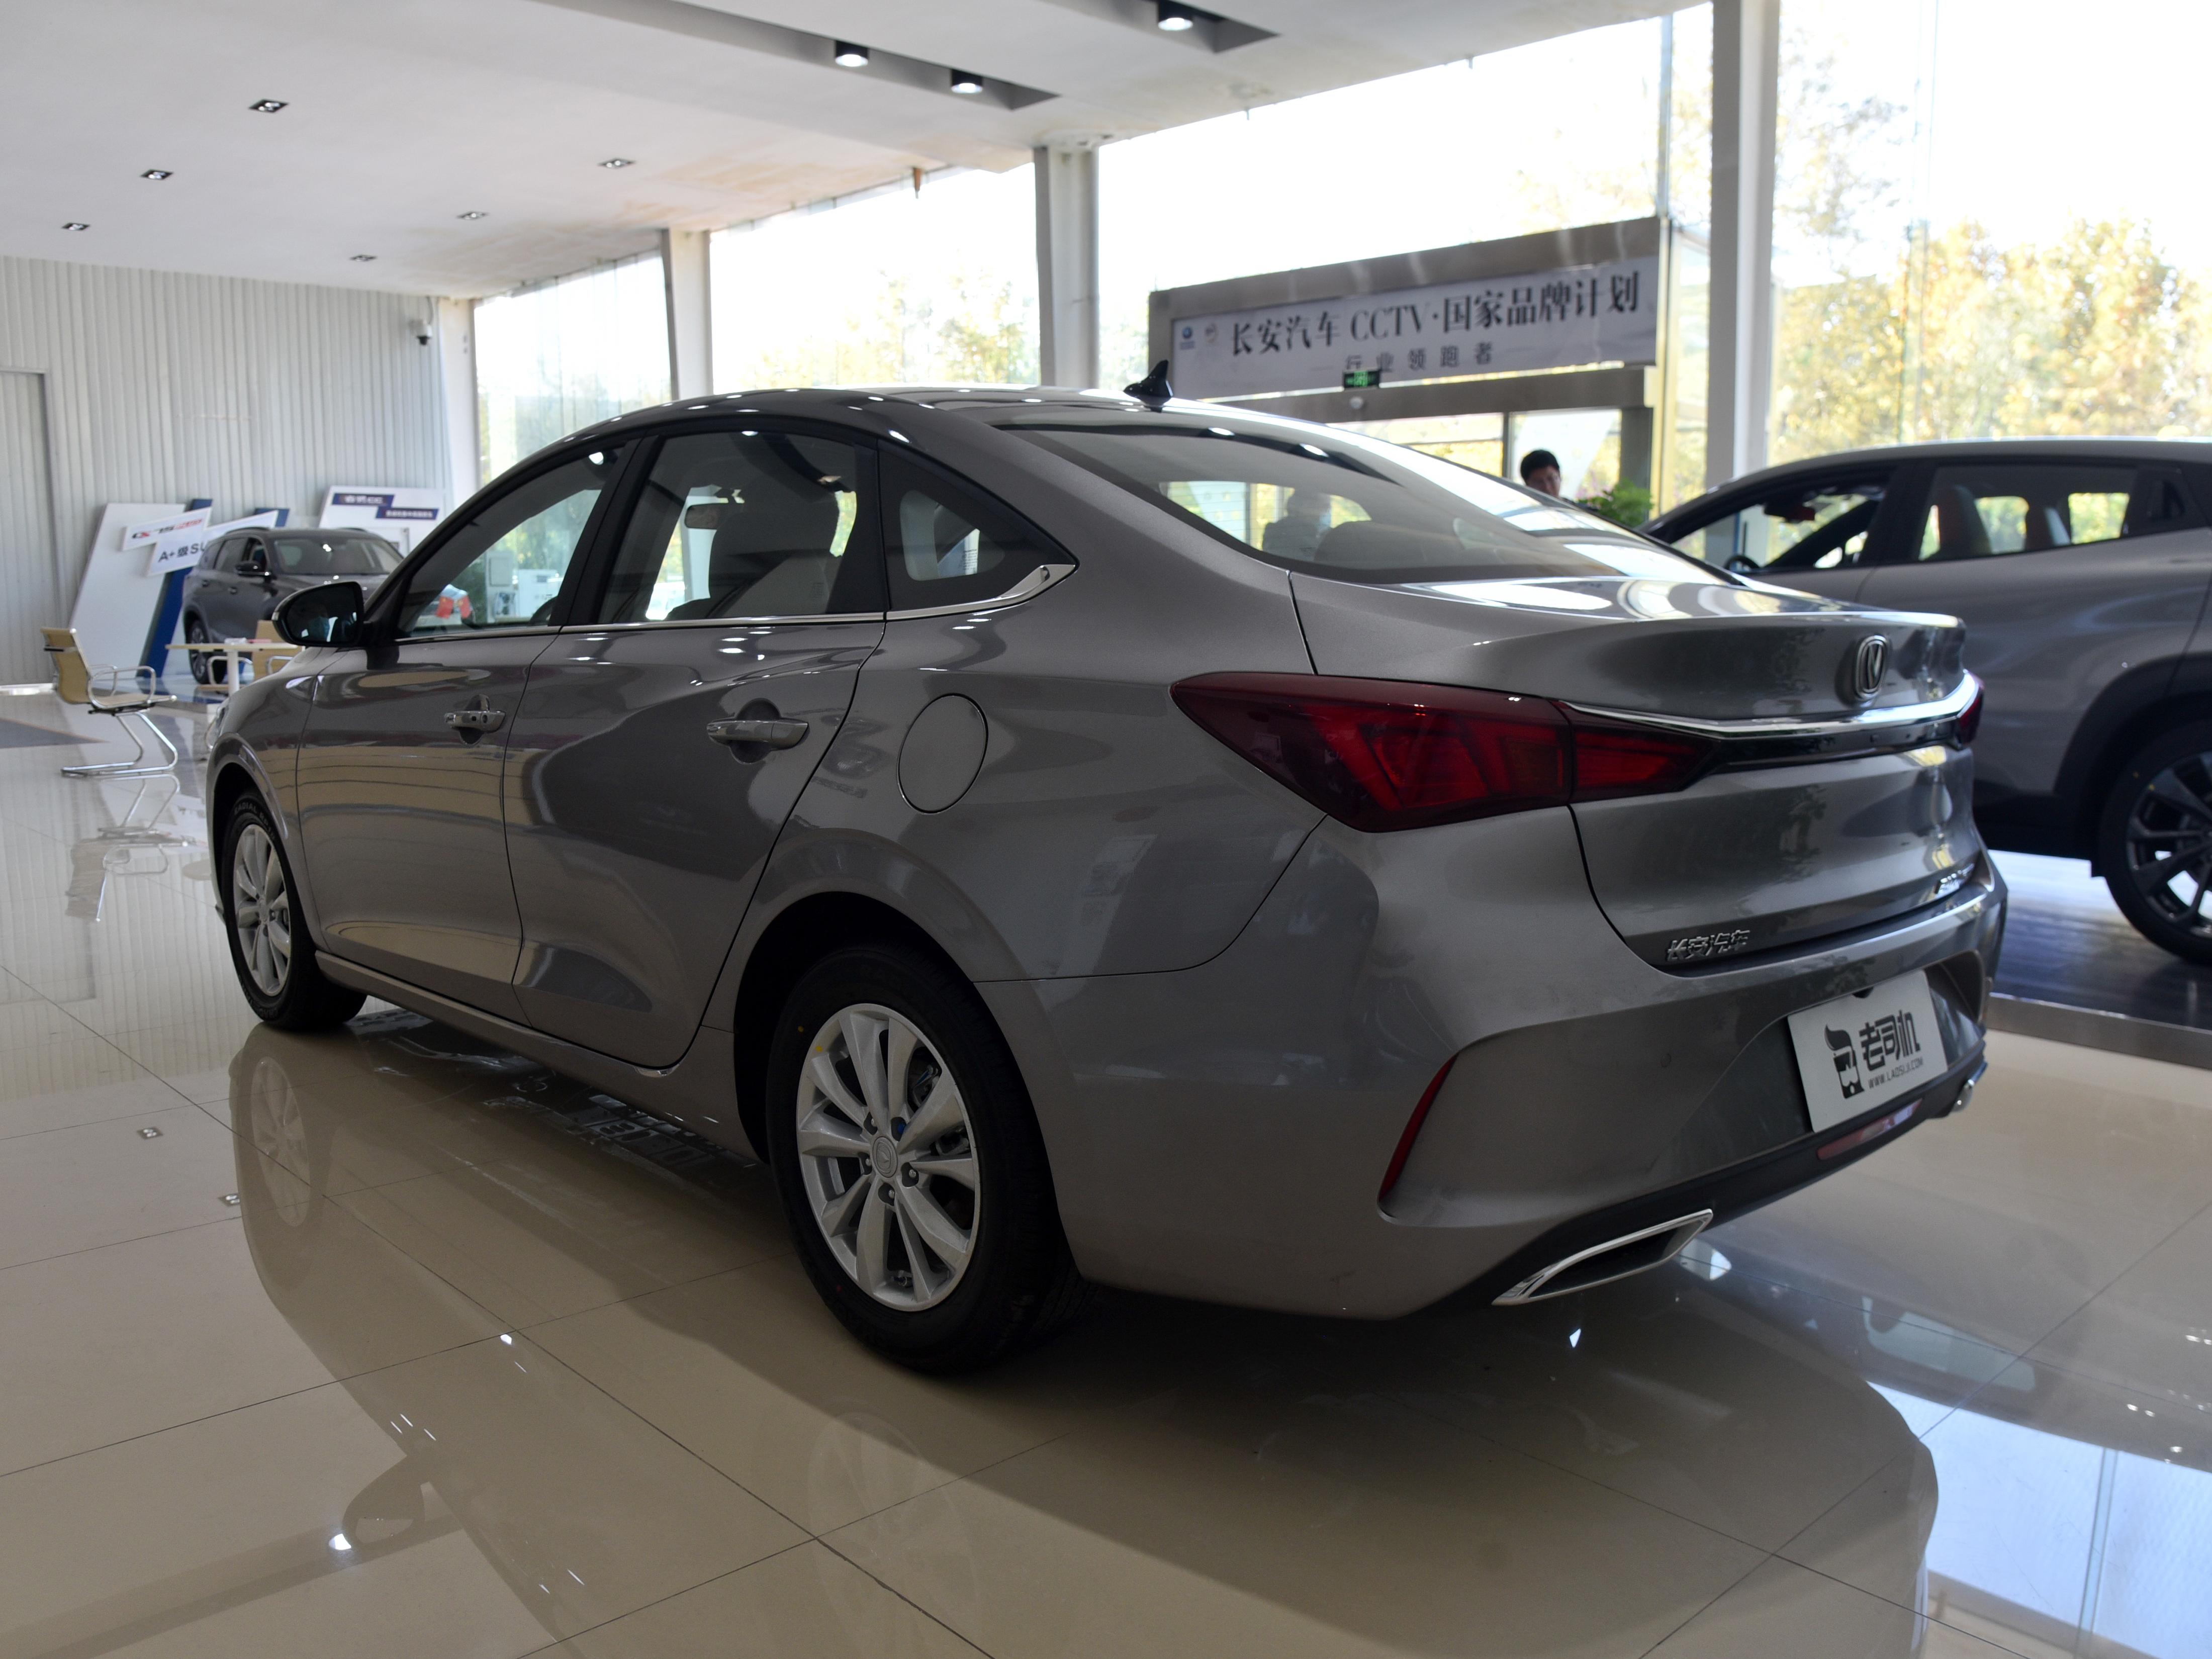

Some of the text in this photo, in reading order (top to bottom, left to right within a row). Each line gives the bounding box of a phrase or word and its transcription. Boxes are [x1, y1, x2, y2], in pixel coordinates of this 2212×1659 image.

[1233, 311, 1340, 355] 长安汽车
[1667, 930, 1750, 961] 长安汽车
[1859, 1009, 1921, 1071] 老司机
